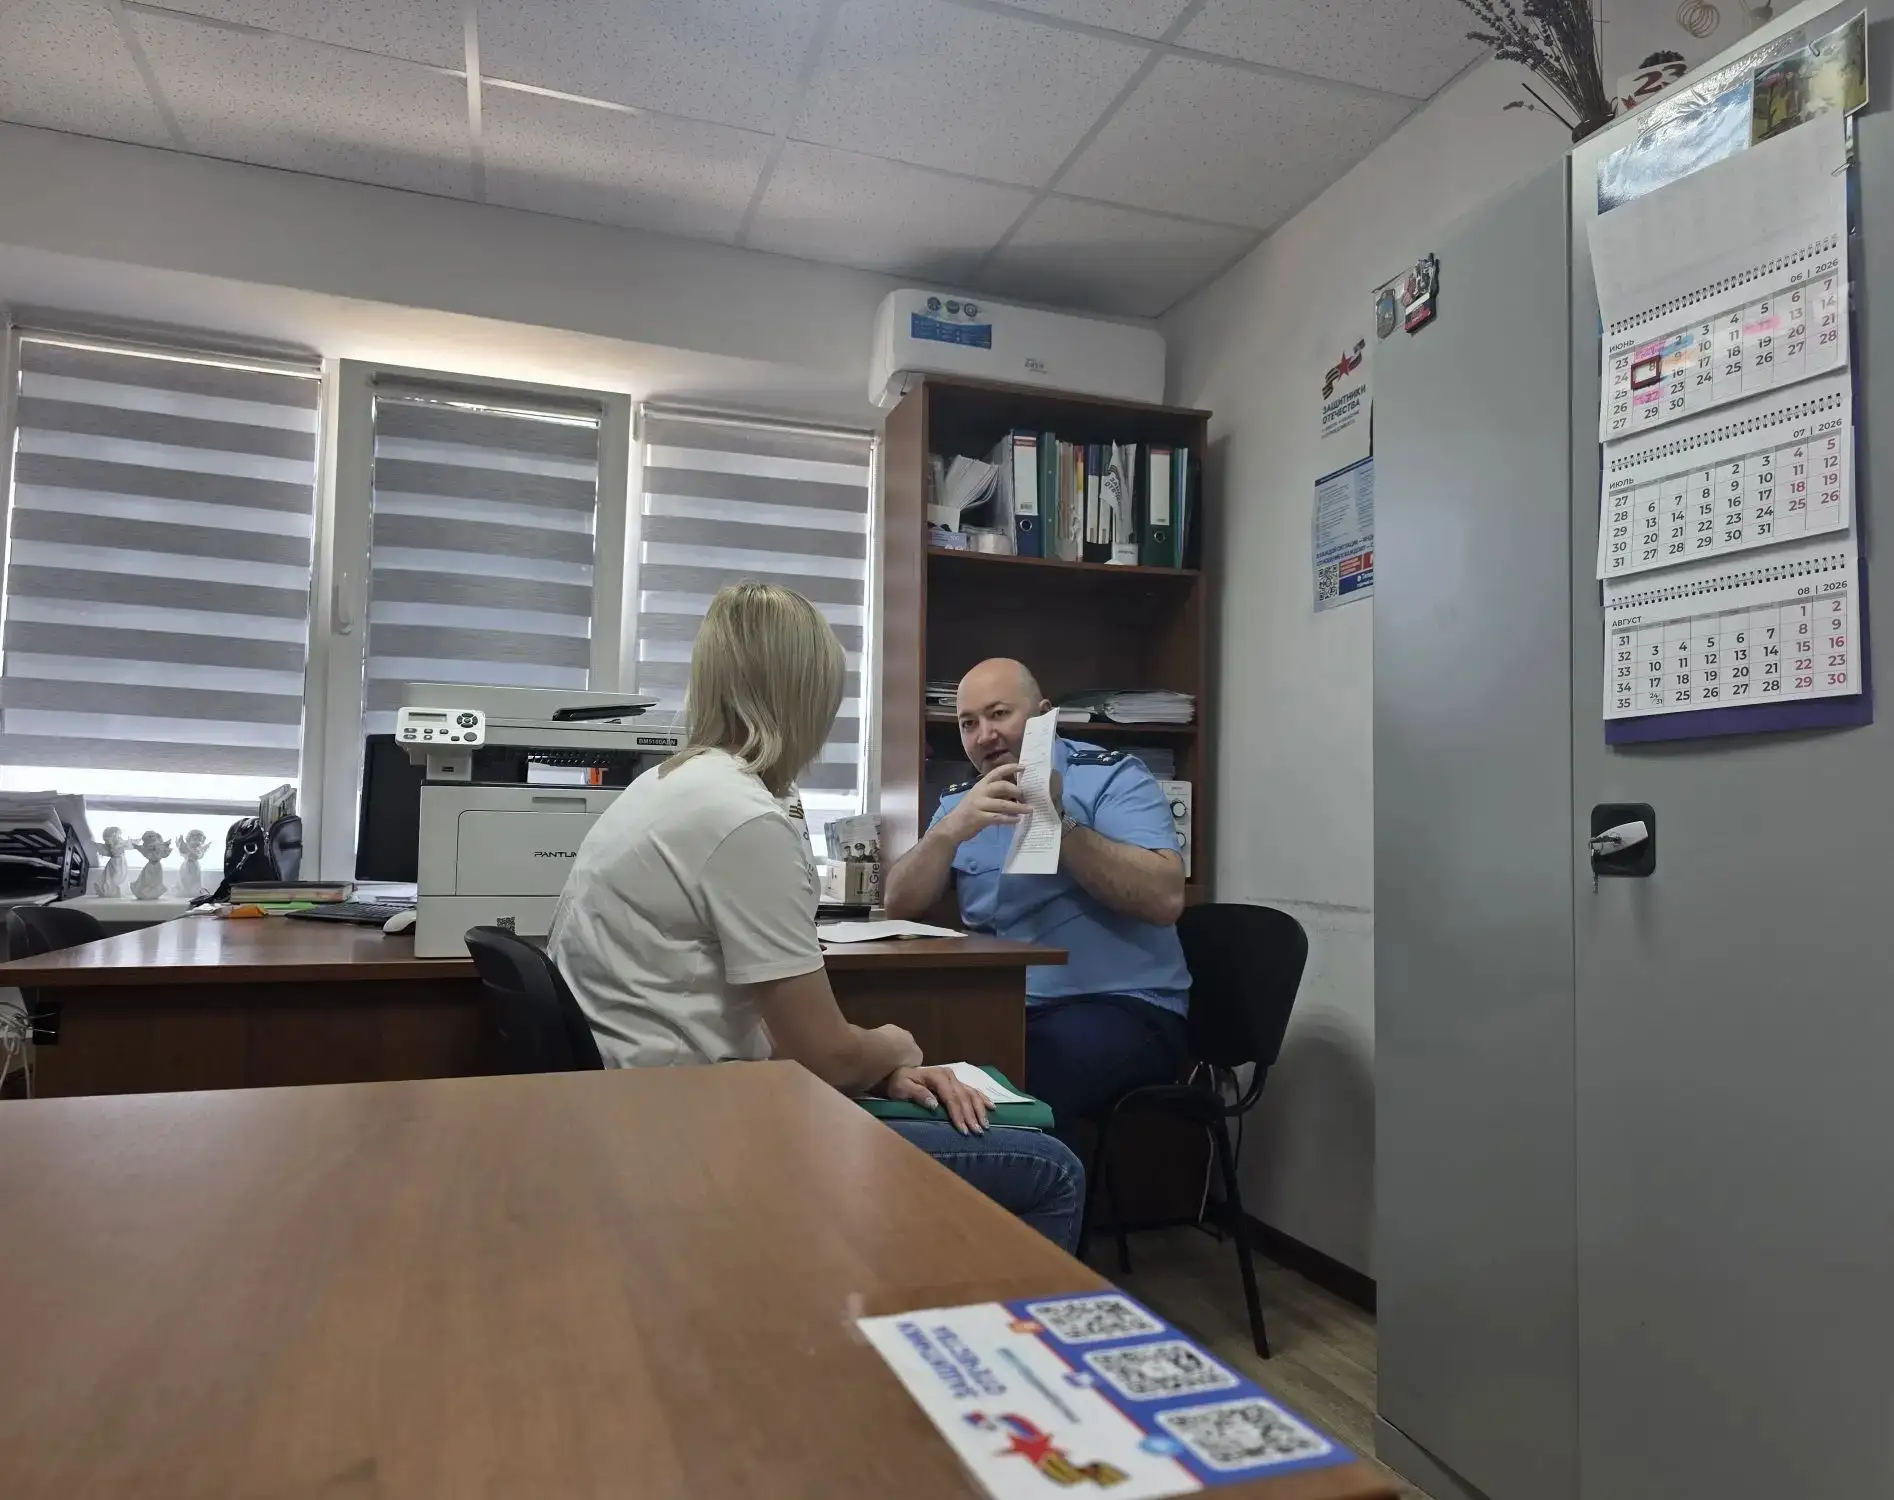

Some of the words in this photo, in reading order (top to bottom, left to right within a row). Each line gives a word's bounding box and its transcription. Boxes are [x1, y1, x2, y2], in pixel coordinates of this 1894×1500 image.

[1790, 273, 1803, 283] 06
[1815, 259, 1838, 273] 2026
[1615, 357, 1628, 370] 23
[1676, 335, 1682, 346] 2
[1702, 325, 1709, 335] 3
[1730, 314, 1739, 324] 4
[1761, 303, 1768, 314] 5
[1791, 291, 1800, 302] 6
[1824, 279, 1832, 291] 7
[1609, 340, 1634, 352] ИЮНЬ
[1614, 373, 1629, 385] 24
[1649, 361, 1655, 371] 8
[1699, 341, 1711, 352] 10
[1729, 330, 1739, 341] 11
[1789, 308, 1803, 320] 13
[1615, 390, 1628, 399] 25
[1699, 356, 1711, 368] 17
[1726, 346, 1741, 358] 18
[1757, 336, 1772, 348] 19
[1788, 324, 1805, 339] 20
[1822, 313, 1835, 327] 21
[1614, 403, 1628, 415] 26
[1671, 382, 1684, 394] 23
[1697, 372, 1712, 385] 24
[1725, 361, 1741, 375] 25
[1756, 352, 1773, 366] 26
[1788, 341, 1805, 356] 27
[1820, 330, 1836, 345] 28
[1612, 418, 1626, 429] 27
[1644, 407, 1658, 419] 29
[1669, 398, 1684, 410] 30
[1793, 429, 1805, 438] 07
[1818, 418, 1842, 432] 2026
[1609, 478, 1634, 489] ИЮЛЬ
[1614, 511, 1628, 522] 28
[1648, 502, 1655, 512] 6
[1675, 495, 1683, 505] 7
[1702, 488, 1710, 498] 8
[1731, 481, 1739, 491] 9
[1758, 472, 1773, 484] 10
[1793, 464, 1804, 476] 11
[1823, 456, 1838, 468] 12
[1615, 496, 1628, 507] 27
[1705, 472, 1709, 481] 1
[1732, 464, 1740, 474] 2
[1762, 456, 1770, 466] 3
[1794, 448, 1803, 458] 4
[1827, 438, 1835, 450] 5
[1612, 542, 1626, 553] 30
[1643, 533, 1658, 545] 20
[1671, 527, 1683, 538] 21
[1698, 520, 1713, 532] 22
[1726, 513, 1741, 525] 23
[1756, 506, 1774, 519] 24
[1789, 498, 1806, 511] 25
[1821, 490, 1839, 504] 26
[1613, 526, 1627, 537] 29
[1646, 517, 1657, 528] 13
[1671, 511, 1684, 522] 14
[1699, 504, 1712, 515] 15
[1728, 496, 1741, 508] 16
[1758, 489, 1772, 501] 17
[1790, 481, 1805, 493] 18
[1823, 473, 1838, 486] 19
[1613, 557, 1624, 567] 31
[1643, 549, 1657, 560] 27
[1669, 543, 1684, 554] 28
[1697, 536, 1712, 548] 29
[1725, 529, 1741, 542] 30
[1758, 523, 1771, 535] 31
[1797, 587, 1810, 595] 08
[1823, 581, 1847, 591] 2026
[1612, 616, 1642, 627] АВГУСТ
[1618, 651, 1631, 661] 32
[1652, 645, 1659, 656] 3
[1679, 642, 1687, 651] 4
[1707, 637, 1714, 647] 5
[1736, 633, 1745, 643] 6
[1767, 628, 1775, 639] 7
[1798, 624, 1808, 634] 8
[1832, 619, 1841, 630] 9
[1619, 636, 1630, 646] 31
[1801, 606, 1805, 616] 1
[1832, 600, 1841, 612] 2
[1617, 667, 1631, 677] 33
[1649, 661, 1662, 672] 10
[1679, 658, 1688, 668] 11
[1705, 654, 1717, 664] 12
[1734, 649, 1747, 660] 13
[1763, 645, 1779, 656] 14
[1796, 641, 1810, 652] 15
[1828, 636, 1844, 648] 16
[1617, 682, 1631, 693] 34
[1649, 677, 1661, 688] 17
[1676, 674, 1689, 685] 18
[1704, 670, 1717, 681] 19
[1732, 667, 1749, 678] 20
[1765, 663, 1778, 674] 21
[1795, 658, 1812, 670] 22
[1828, 654, 1845, 667] 23
[1617, 698, 1631, 708] 35
[1676, 690, 1690, 701] 25
[1703, 687, 1718, 698] 26
[1733, 684, 1749, 695] 27
[1762, 680, 1779, 692] 28
[1795, 676, 1812, 688] 29
[1828, 673, 1846, 685] 30
